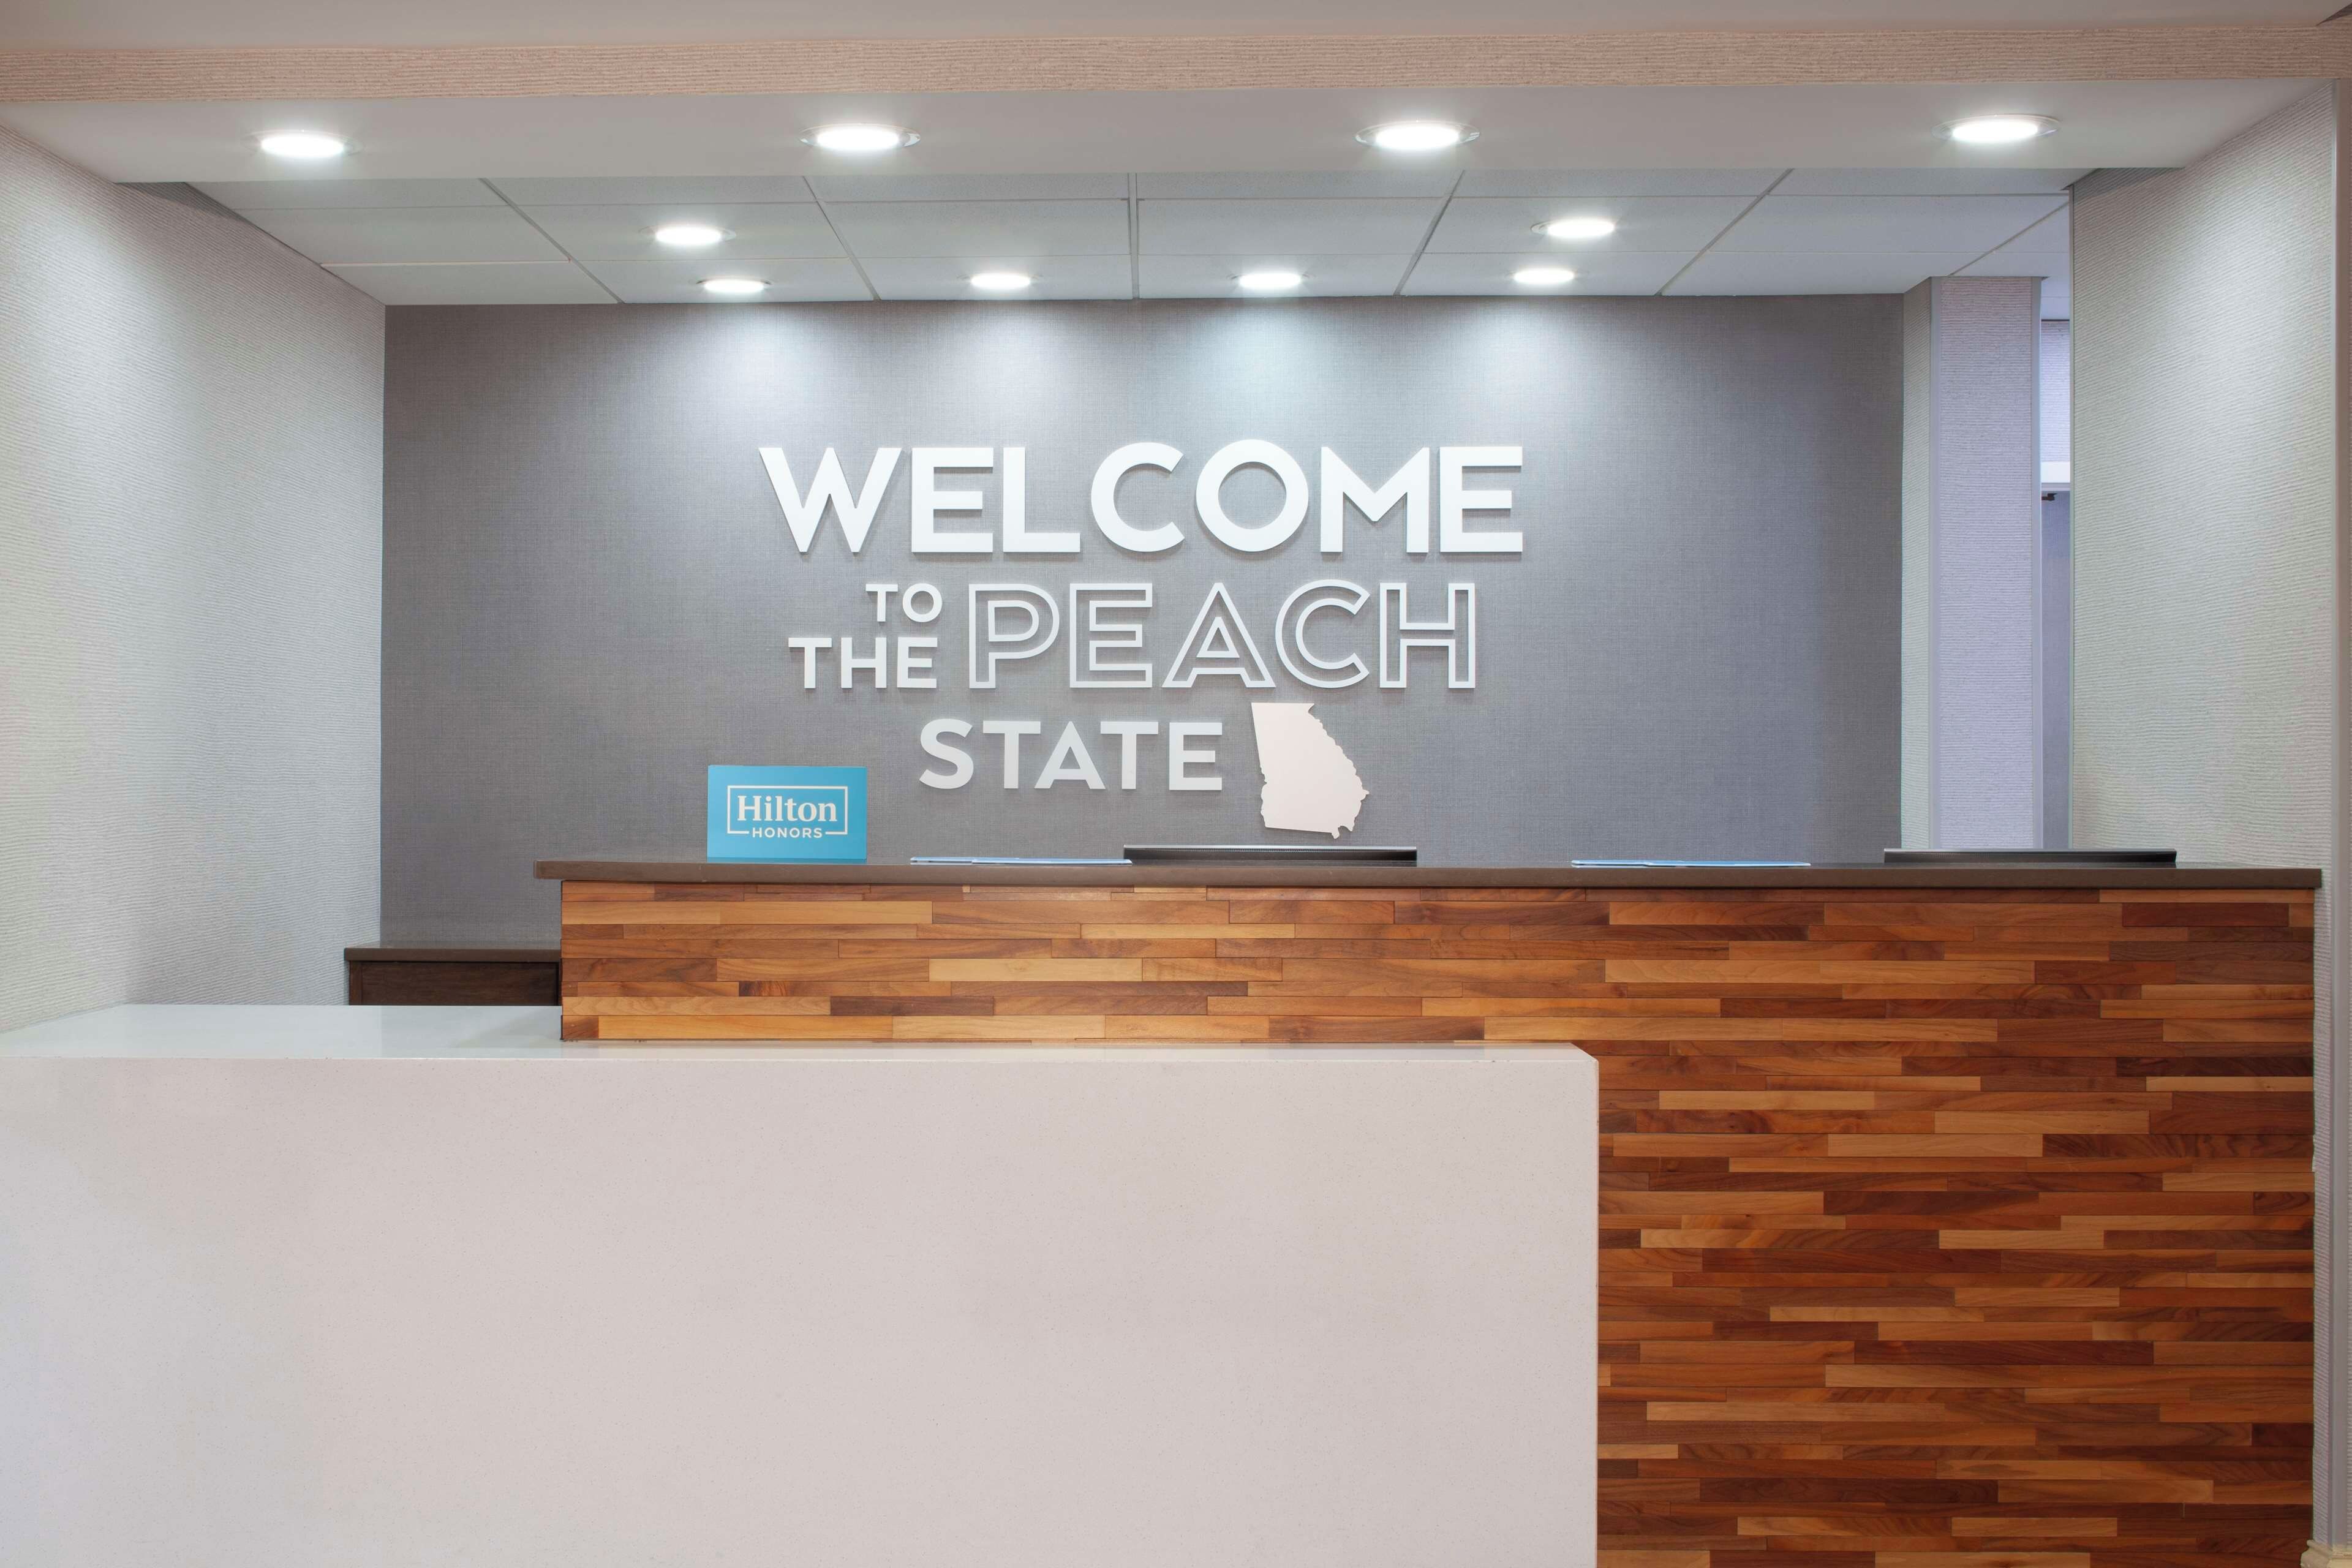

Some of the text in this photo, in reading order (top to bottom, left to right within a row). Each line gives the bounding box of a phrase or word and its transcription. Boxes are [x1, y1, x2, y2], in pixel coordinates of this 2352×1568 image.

[758, 439, 1523, 552] WELCOME
[865, 583, 943, 622] TO
[788, 579, 1476, 688] THE PEACH
[919, 718, 1223, 791] STATE
[737, 795, 838, 822] Hilton
[752, 827, 823, 839] HONORS
